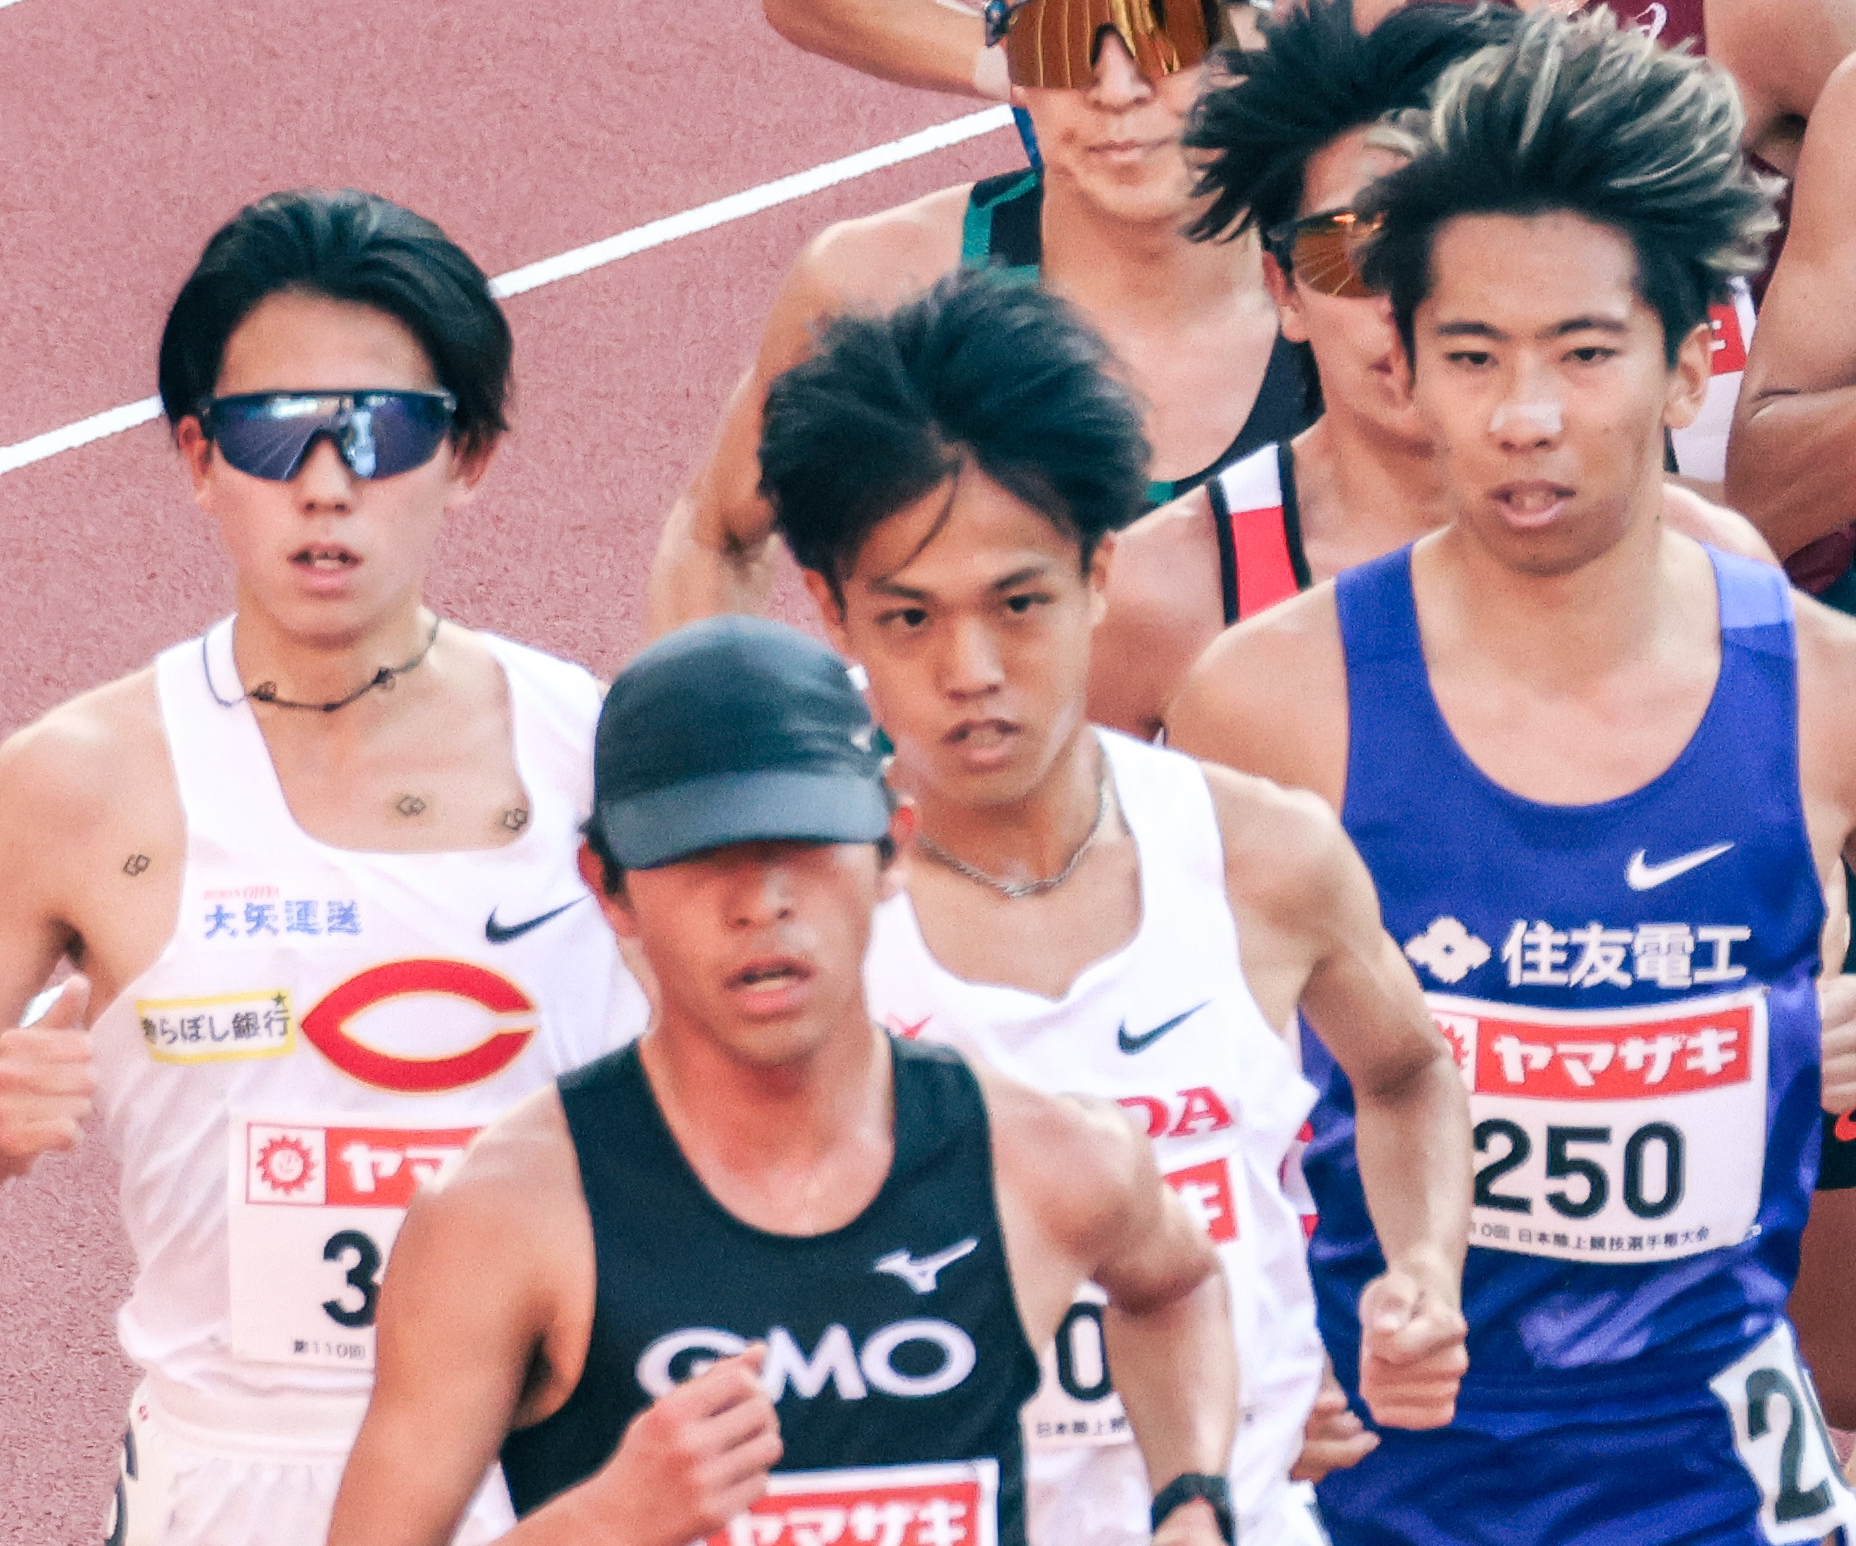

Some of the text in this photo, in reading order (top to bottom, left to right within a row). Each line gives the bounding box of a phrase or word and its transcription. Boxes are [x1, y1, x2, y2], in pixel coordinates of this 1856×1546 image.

[1502, 919, 1752, 990] 住友電工
[1492, 1027, 1740, 1087] ヤマザキ
[1473, 1117, 1687, 1221] 250
[1746, 1367, 1842, 1525] 2
